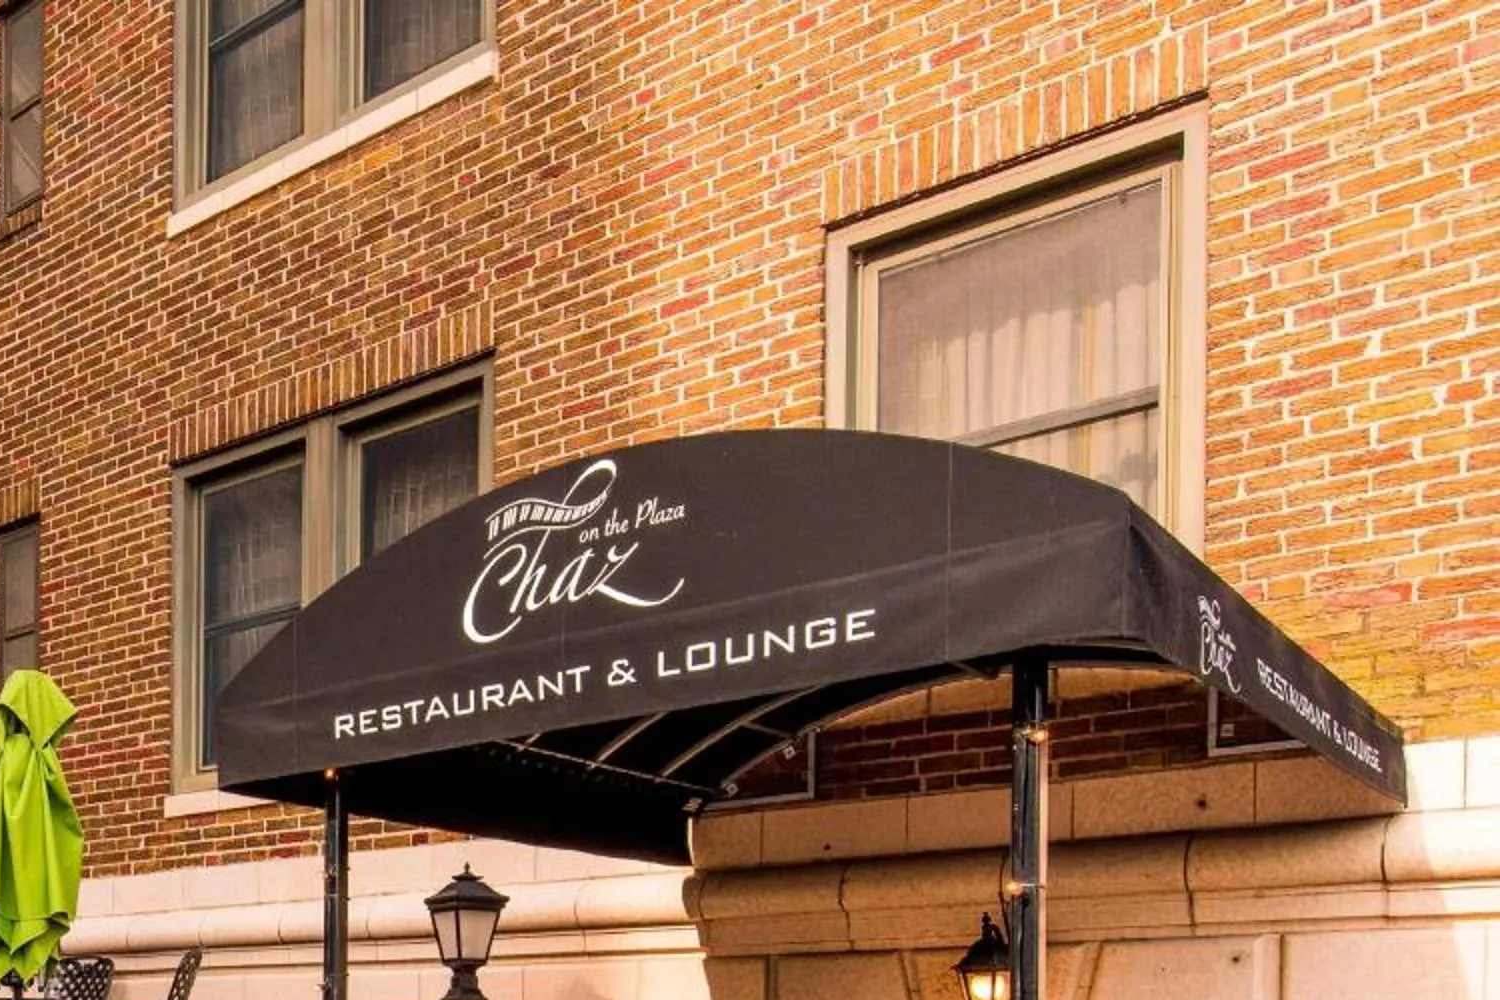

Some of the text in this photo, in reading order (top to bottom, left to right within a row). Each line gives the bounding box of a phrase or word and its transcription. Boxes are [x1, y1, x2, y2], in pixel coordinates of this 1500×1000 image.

[579, 497, 686, 544] on the Plaza
[463, 527, 685, 643] Chaz
[334, 608, 878, 740] RESTAURANT & LOUNGE
[1256, 657, 1332, 739] RESTAURANT
[1342, 726, 1384, 773] LOUNGE
